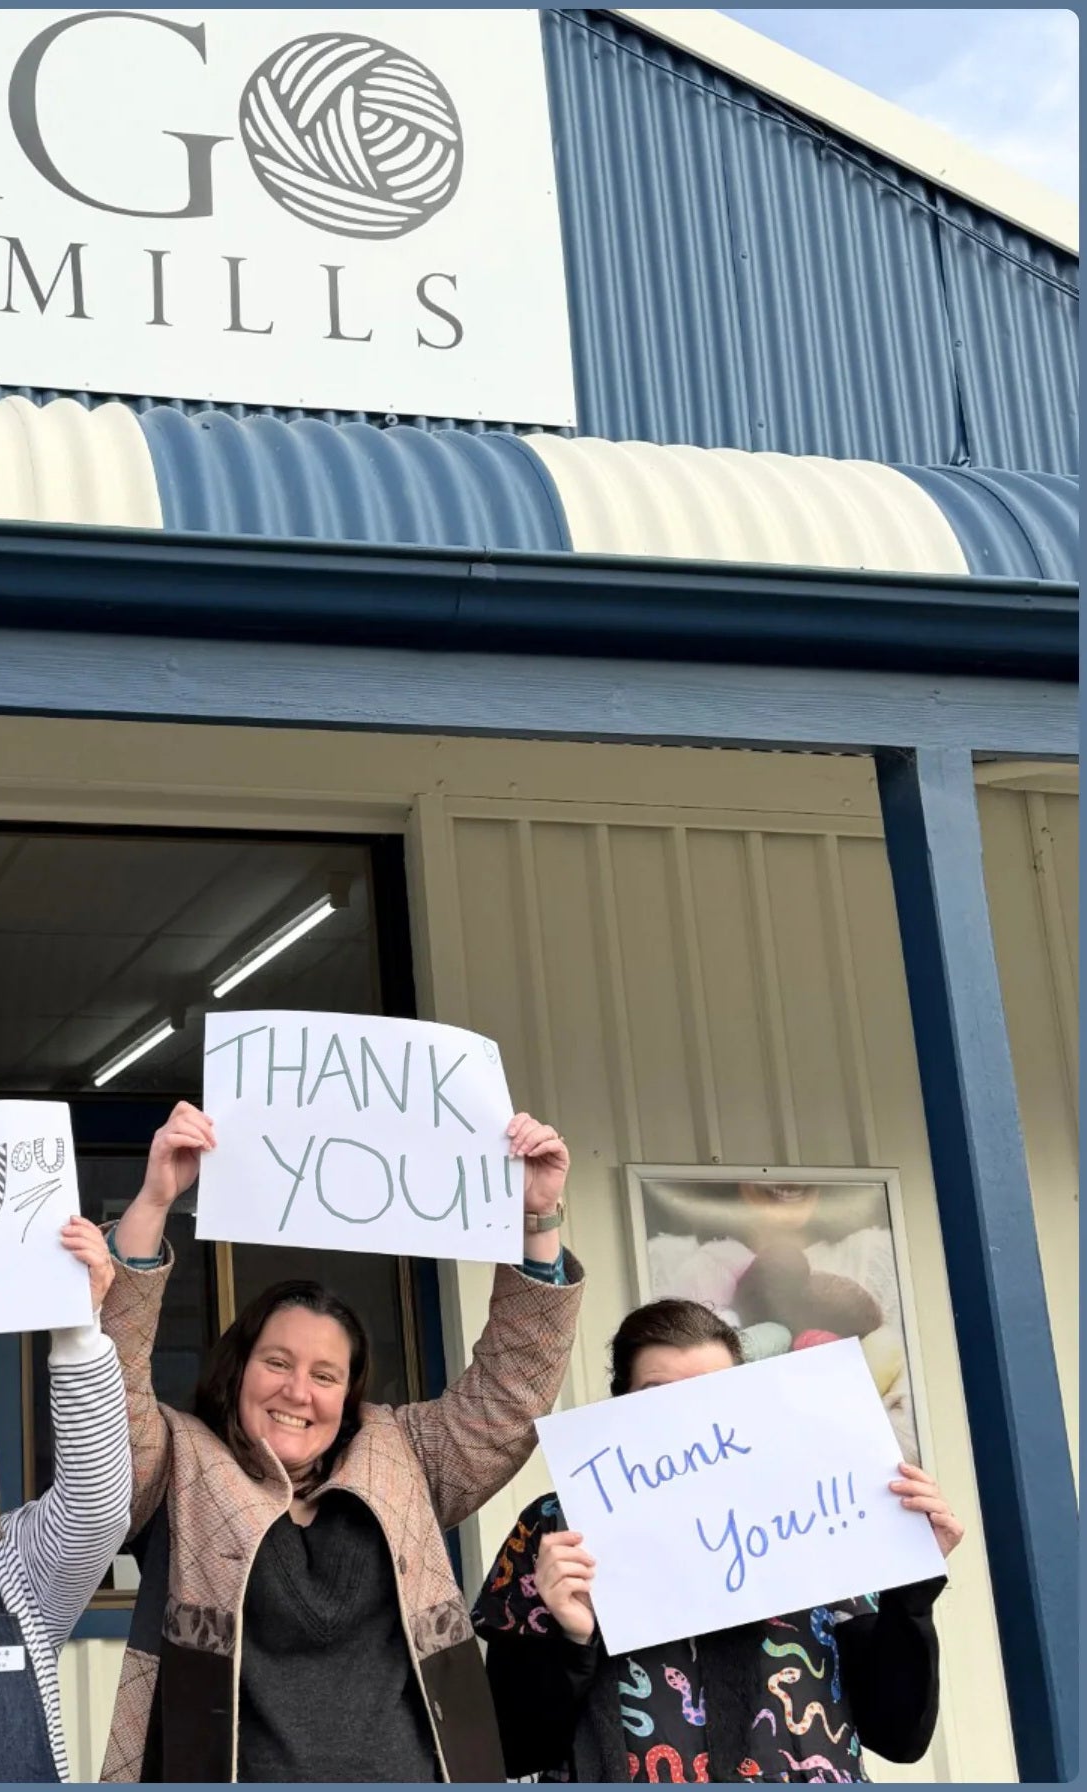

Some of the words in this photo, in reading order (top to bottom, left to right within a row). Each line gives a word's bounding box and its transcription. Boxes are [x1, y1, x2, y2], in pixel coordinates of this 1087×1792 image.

[205, 1025, 476, 1134] THANK
[261, 1134, 514, 1232] YOU!!
[570, 1422, 753, 1514] Thank
[695, 1471, 867, 1594] You!!!
